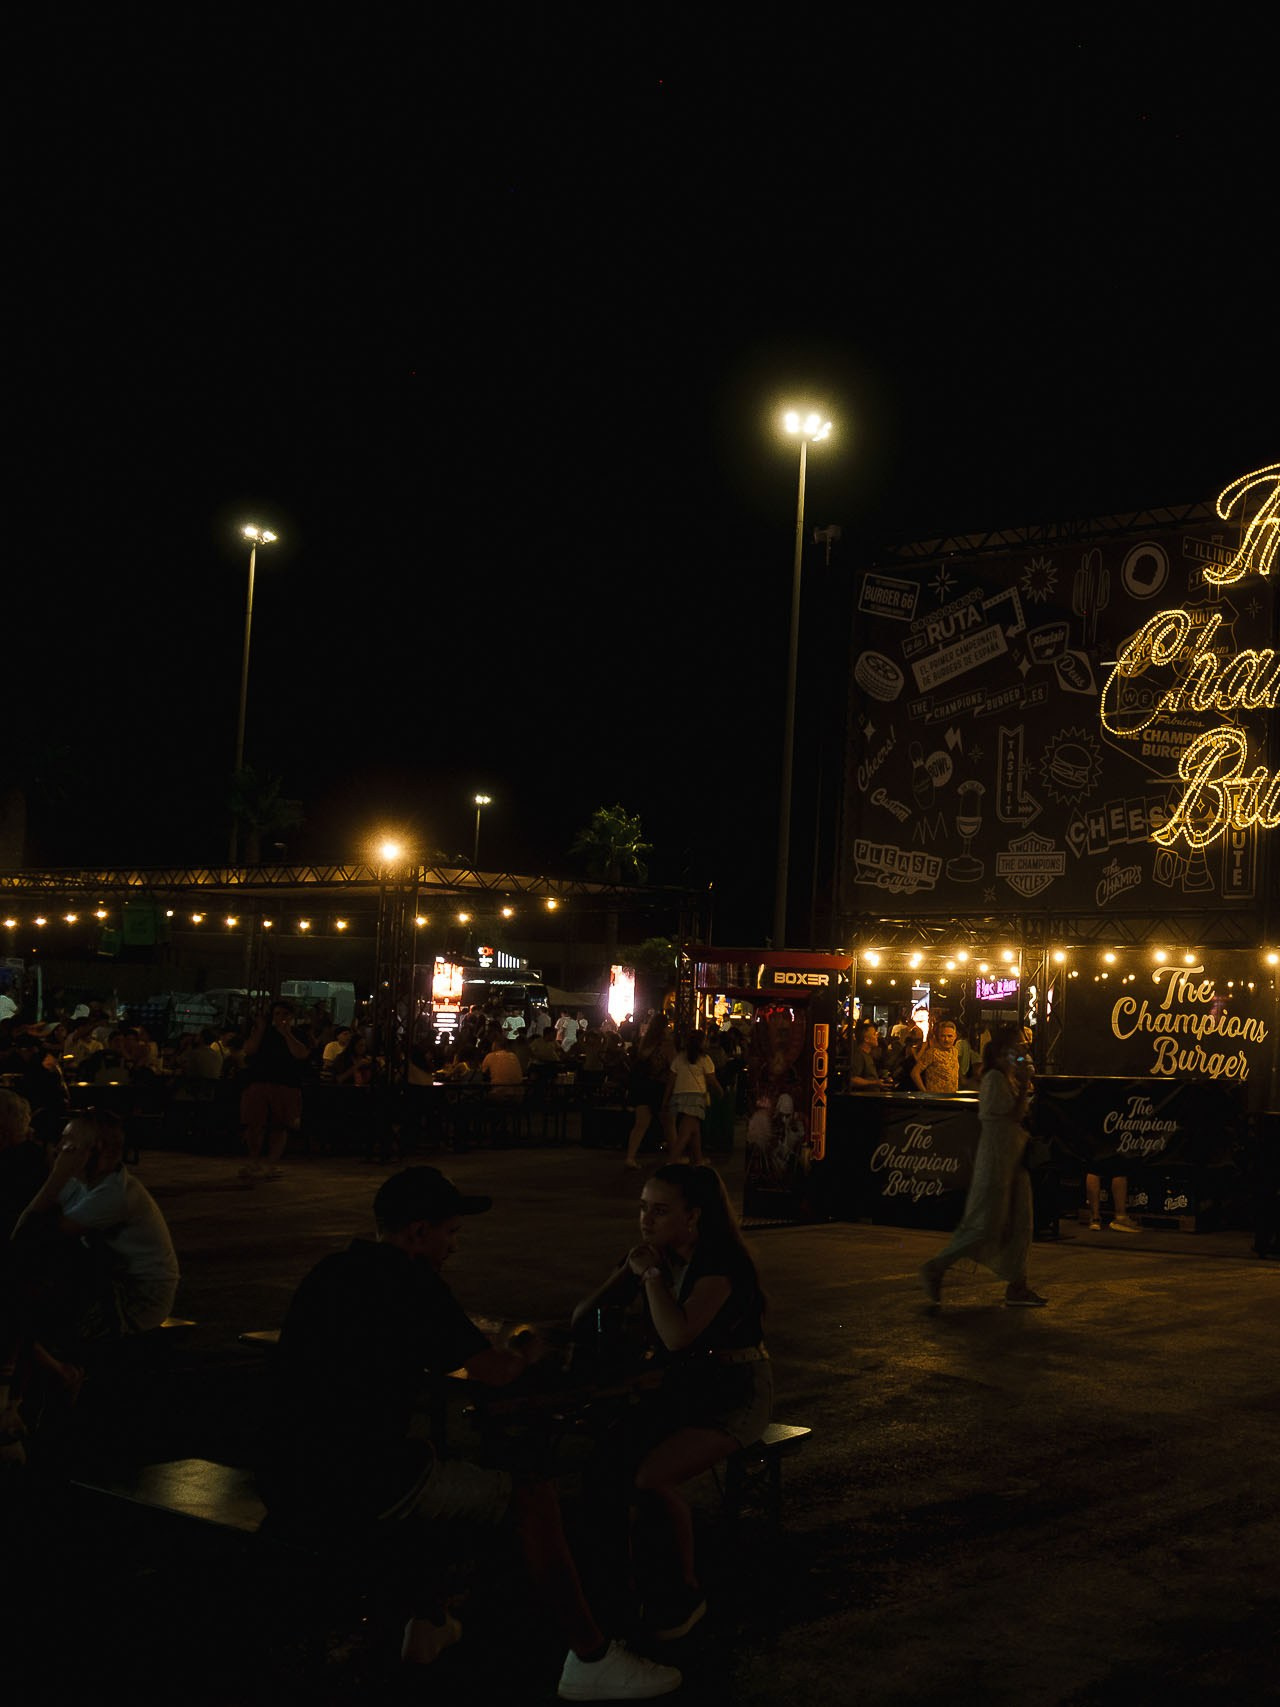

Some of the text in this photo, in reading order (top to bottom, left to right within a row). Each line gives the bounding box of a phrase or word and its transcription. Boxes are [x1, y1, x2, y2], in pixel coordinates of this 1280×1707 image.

[864, 584, 899, 608] BURGER
[900, 592, 914, 610] 66
[926, 604, 983, 646] RUTA
[857, 724, 897, 792] Cheers!
[856, 841, 940, 877] PLEASE
[773, 971, 830, 987] BOXER
[1152, 965, 1217, 1010] The
[1111, 996, 1269, 1044] Champions
[1150, 1036, 1250, 1081] Burger
[809, 1023, 830, 1162] BOXER
[1127, 1096, 1155, 1119] The
[901, 1122, 934, 1153] The
[1103, 1110, 1178, 1135] Champions
[870, 1142, 960, 1174] Champions
[1116, 1131, 1169, 1158] Burger
[881, 1169, 945, 1203] Burger
